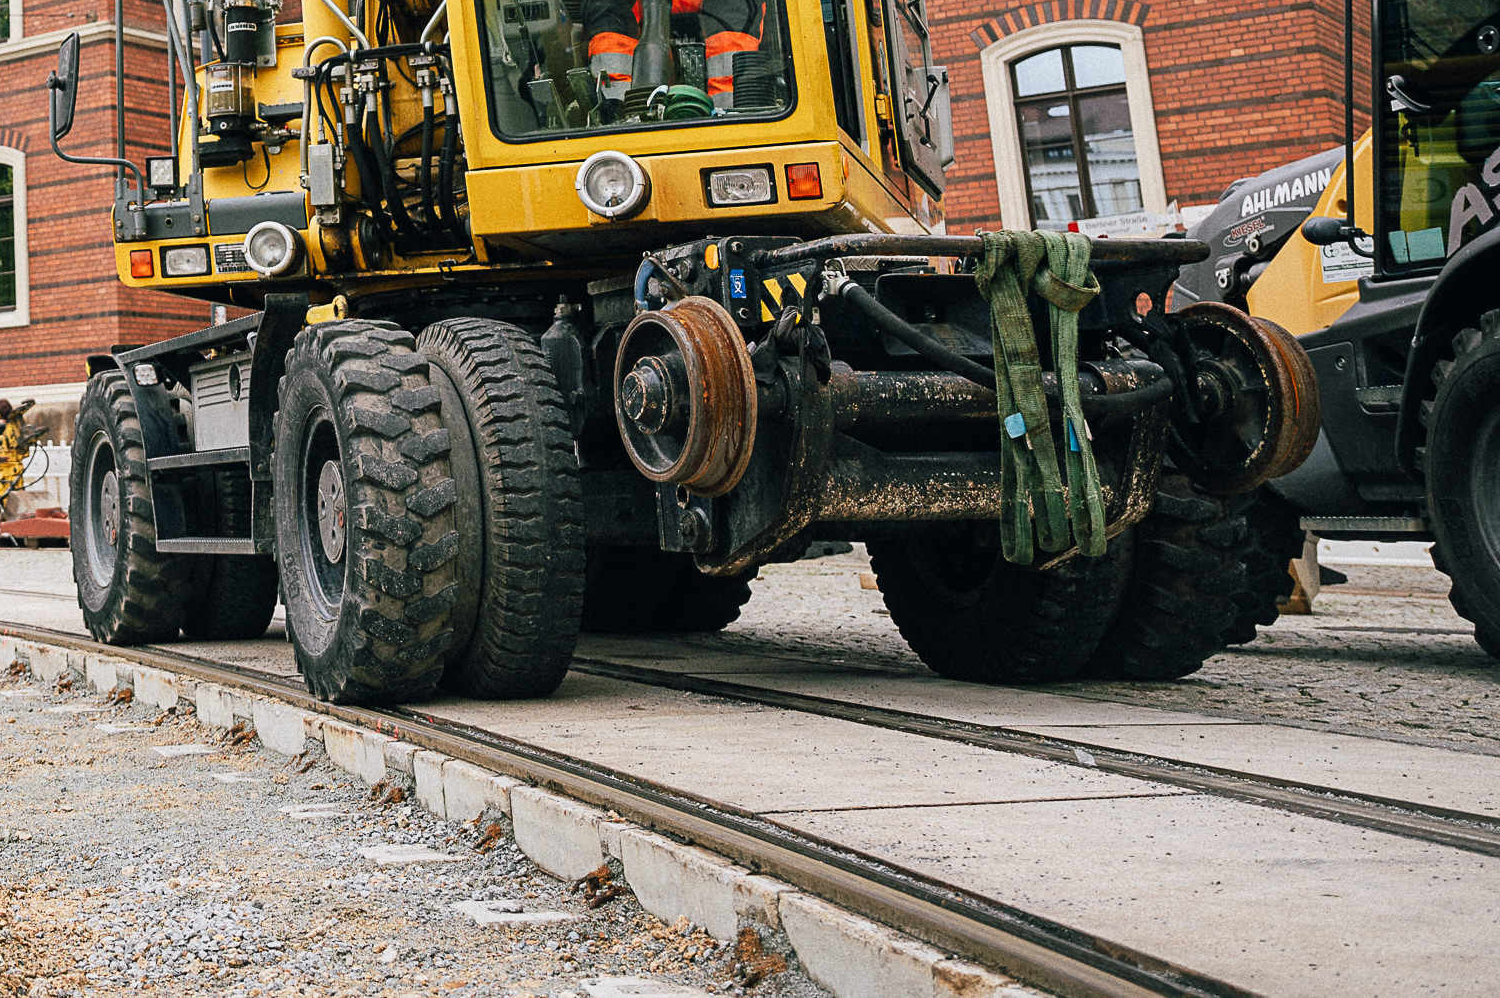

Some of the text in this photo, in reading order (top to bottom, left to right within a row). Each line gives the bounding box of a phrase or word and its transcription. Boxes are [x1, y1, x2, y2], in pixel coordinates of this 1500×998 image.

[1241, 167, 1331, 218] AHLMANN
[1085, 216, 1148, 230] Berliner Straße
[1230, 219, 1266, 238] KIESEL
